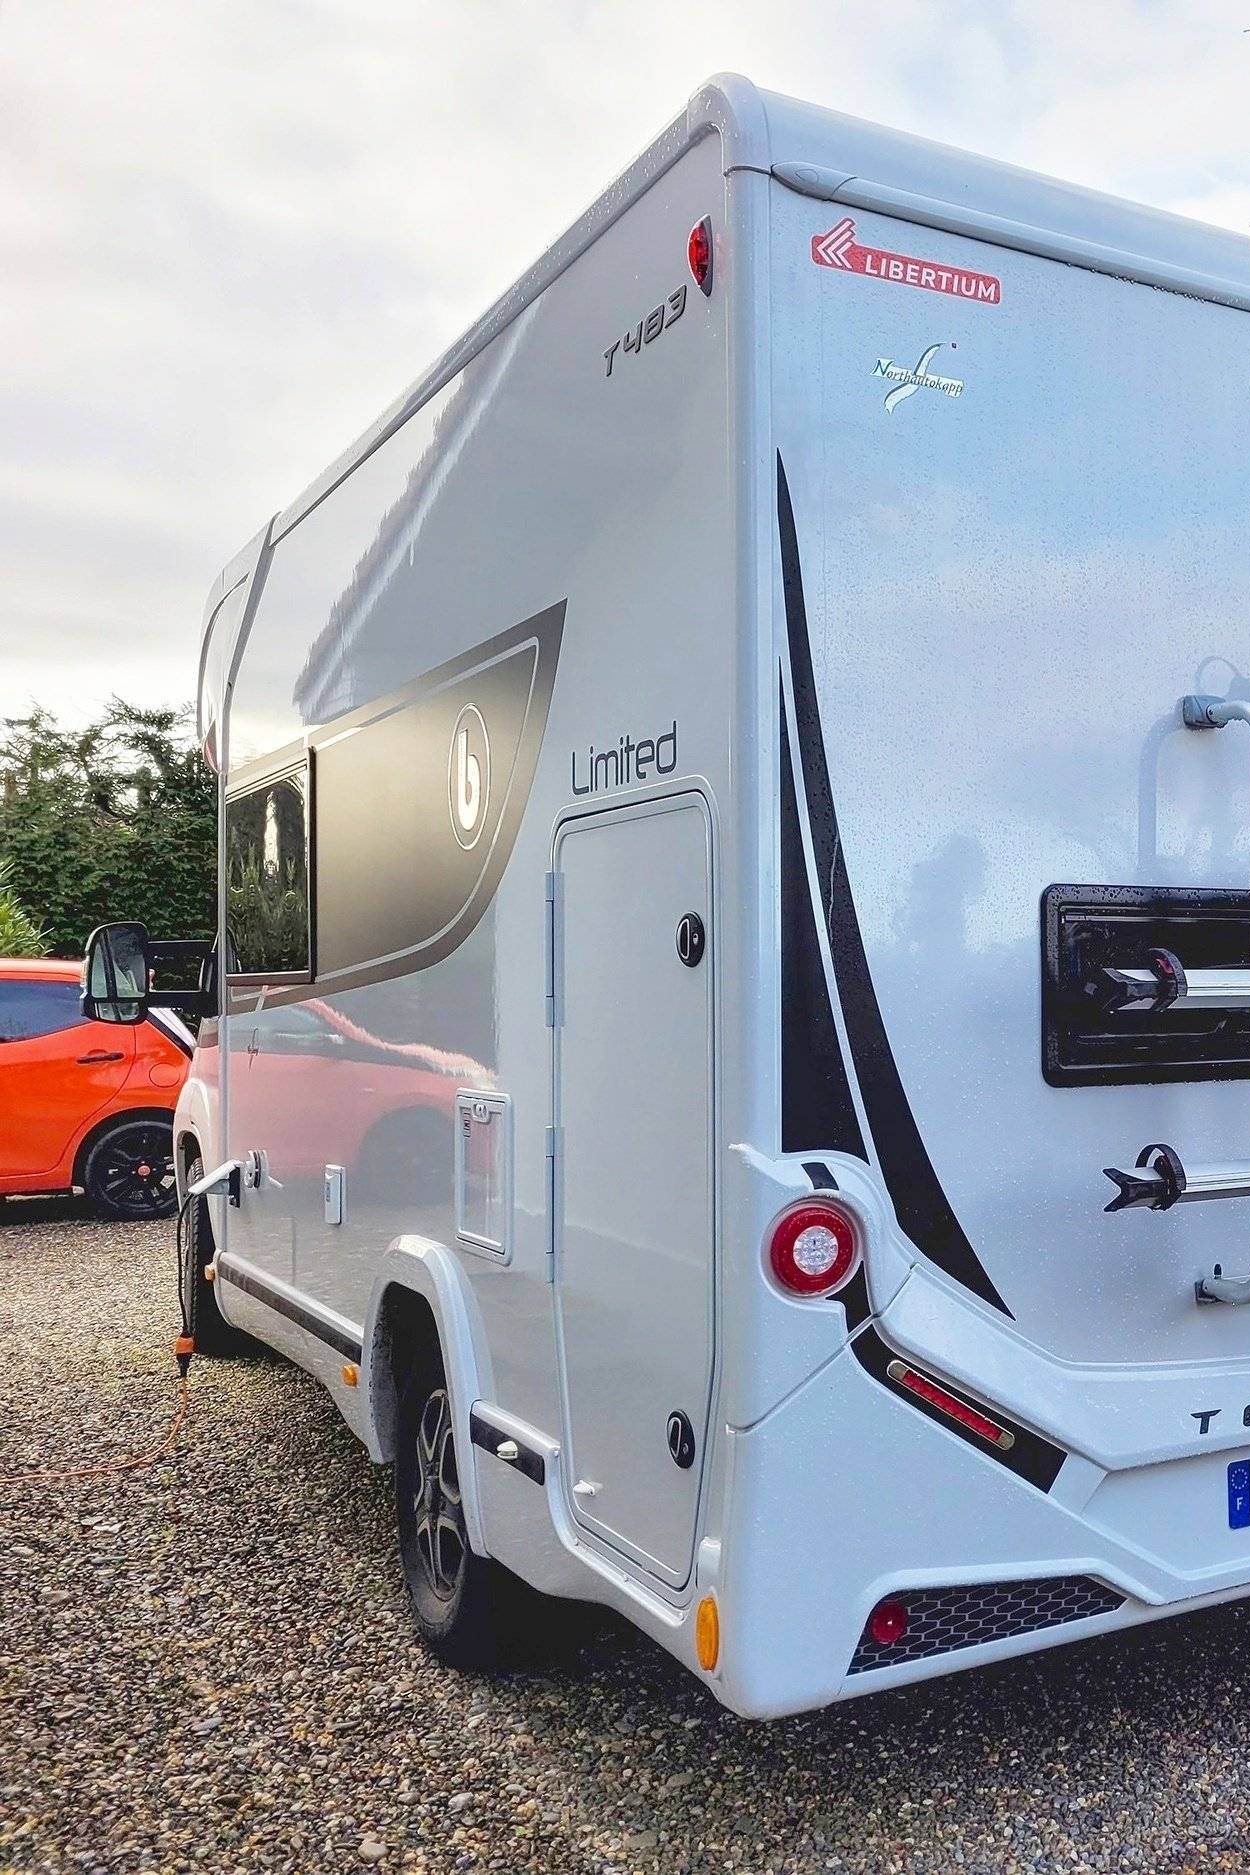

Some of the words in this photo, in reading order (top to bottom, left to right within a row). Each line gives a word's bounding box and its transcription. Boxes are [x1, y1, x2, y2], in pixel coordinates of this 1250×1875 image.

[864, 254, 996, 301] LIBERTIUM
[603, 284, 687, 377] T483
[571, 720, 677, 796] Limited
[1236, 1496, 1243, 1511] F
